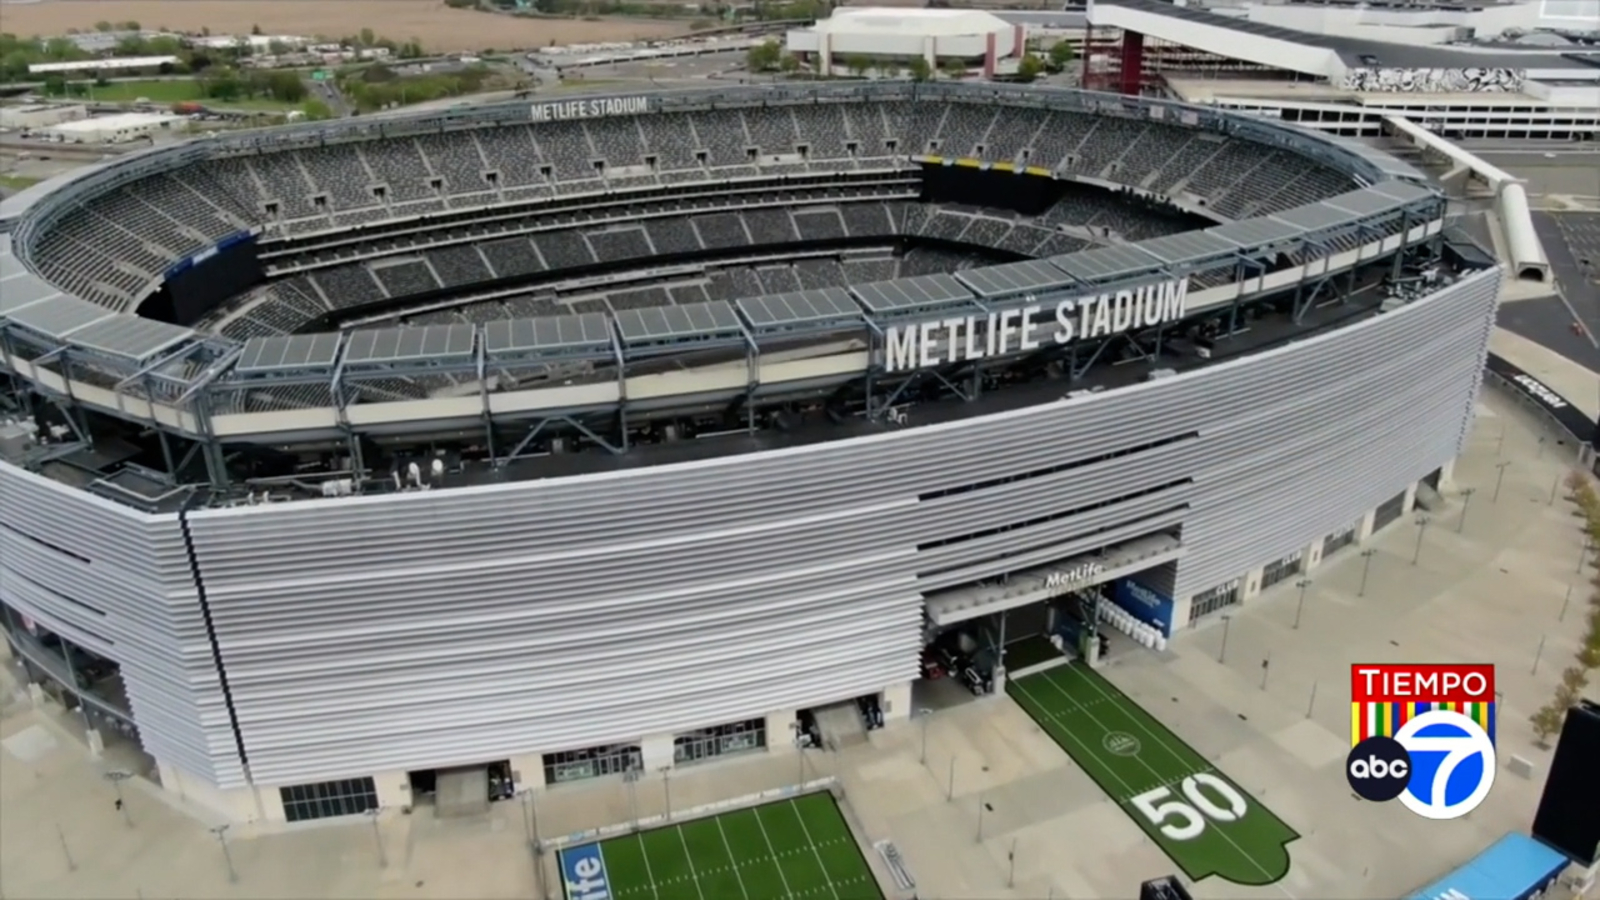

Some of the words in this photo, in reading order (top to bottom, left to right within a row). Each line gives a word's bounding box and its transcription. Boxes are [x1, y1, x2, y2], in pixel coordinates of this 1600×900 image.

[531, 100, 588, 121] METLIFE
[590, 96, 648, 116] STADIUM
[885, 305, 1042, 372] METLIFE
[1053, 278, 1189, 344] STADIUM
[1045, 562, 1103, 588] MetLife
[1130, 772, 1248, 841] 50
